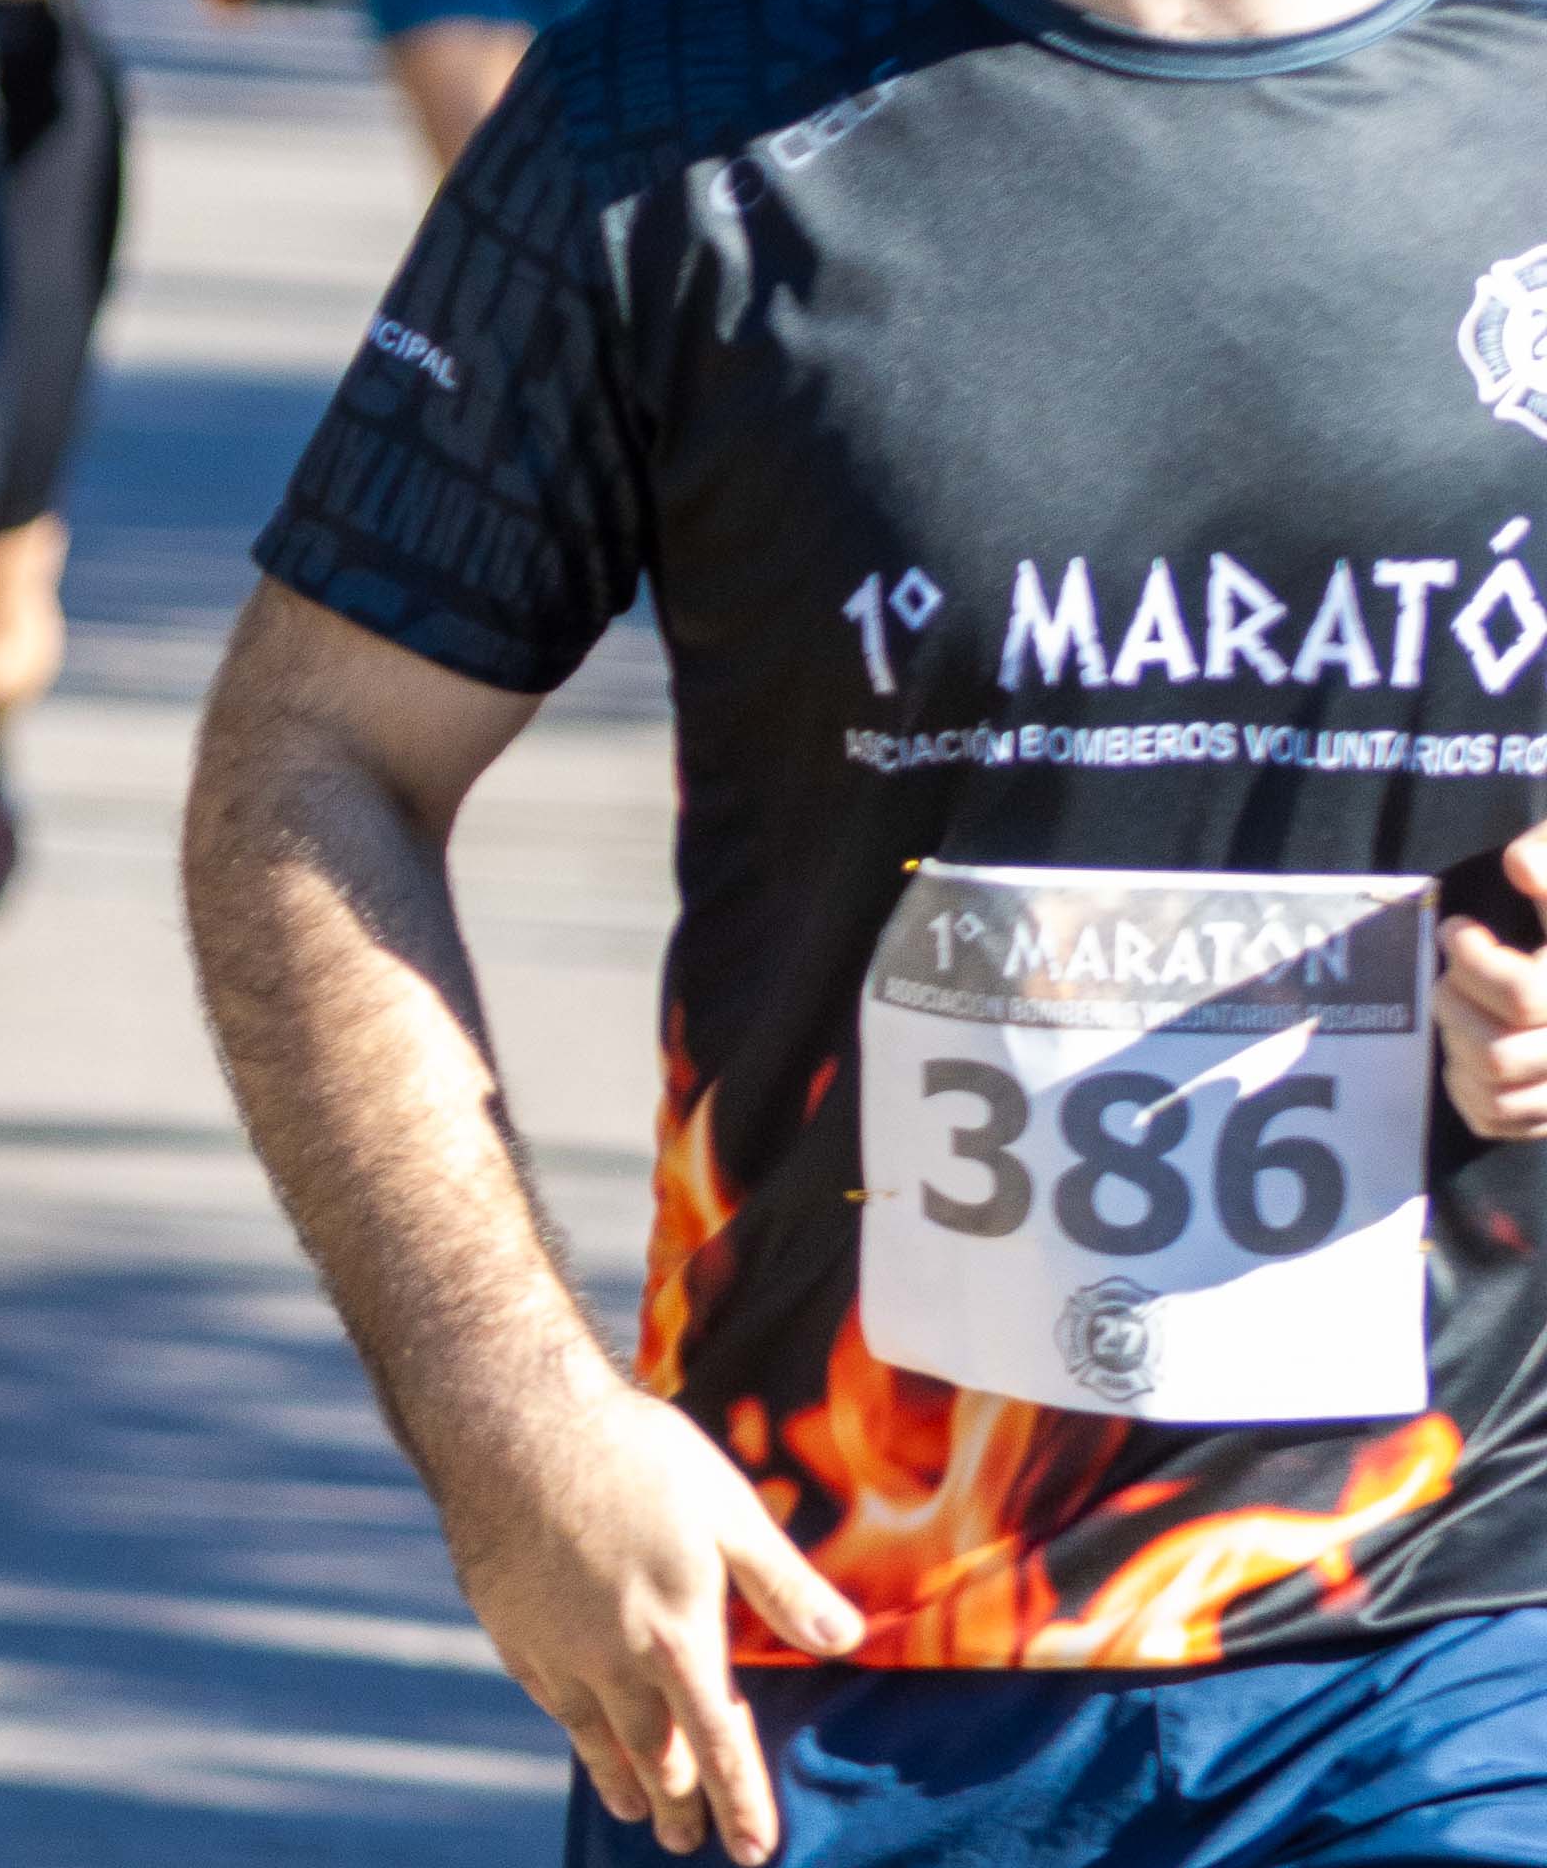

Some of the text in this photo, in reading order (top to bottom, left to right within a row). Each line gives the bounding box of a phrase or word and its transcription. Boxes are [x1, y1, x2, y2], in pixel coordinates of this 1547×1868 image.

[842, 565, 944, 696] 1°
[1019, 721, 1238, 767] BOMBEROS
[1244, 724, 1497, 777] VOLUNTARIOS
[926, 902, 1349, 986] 1° MARATÓN
[921, 1058, 1346, 1256] 386
